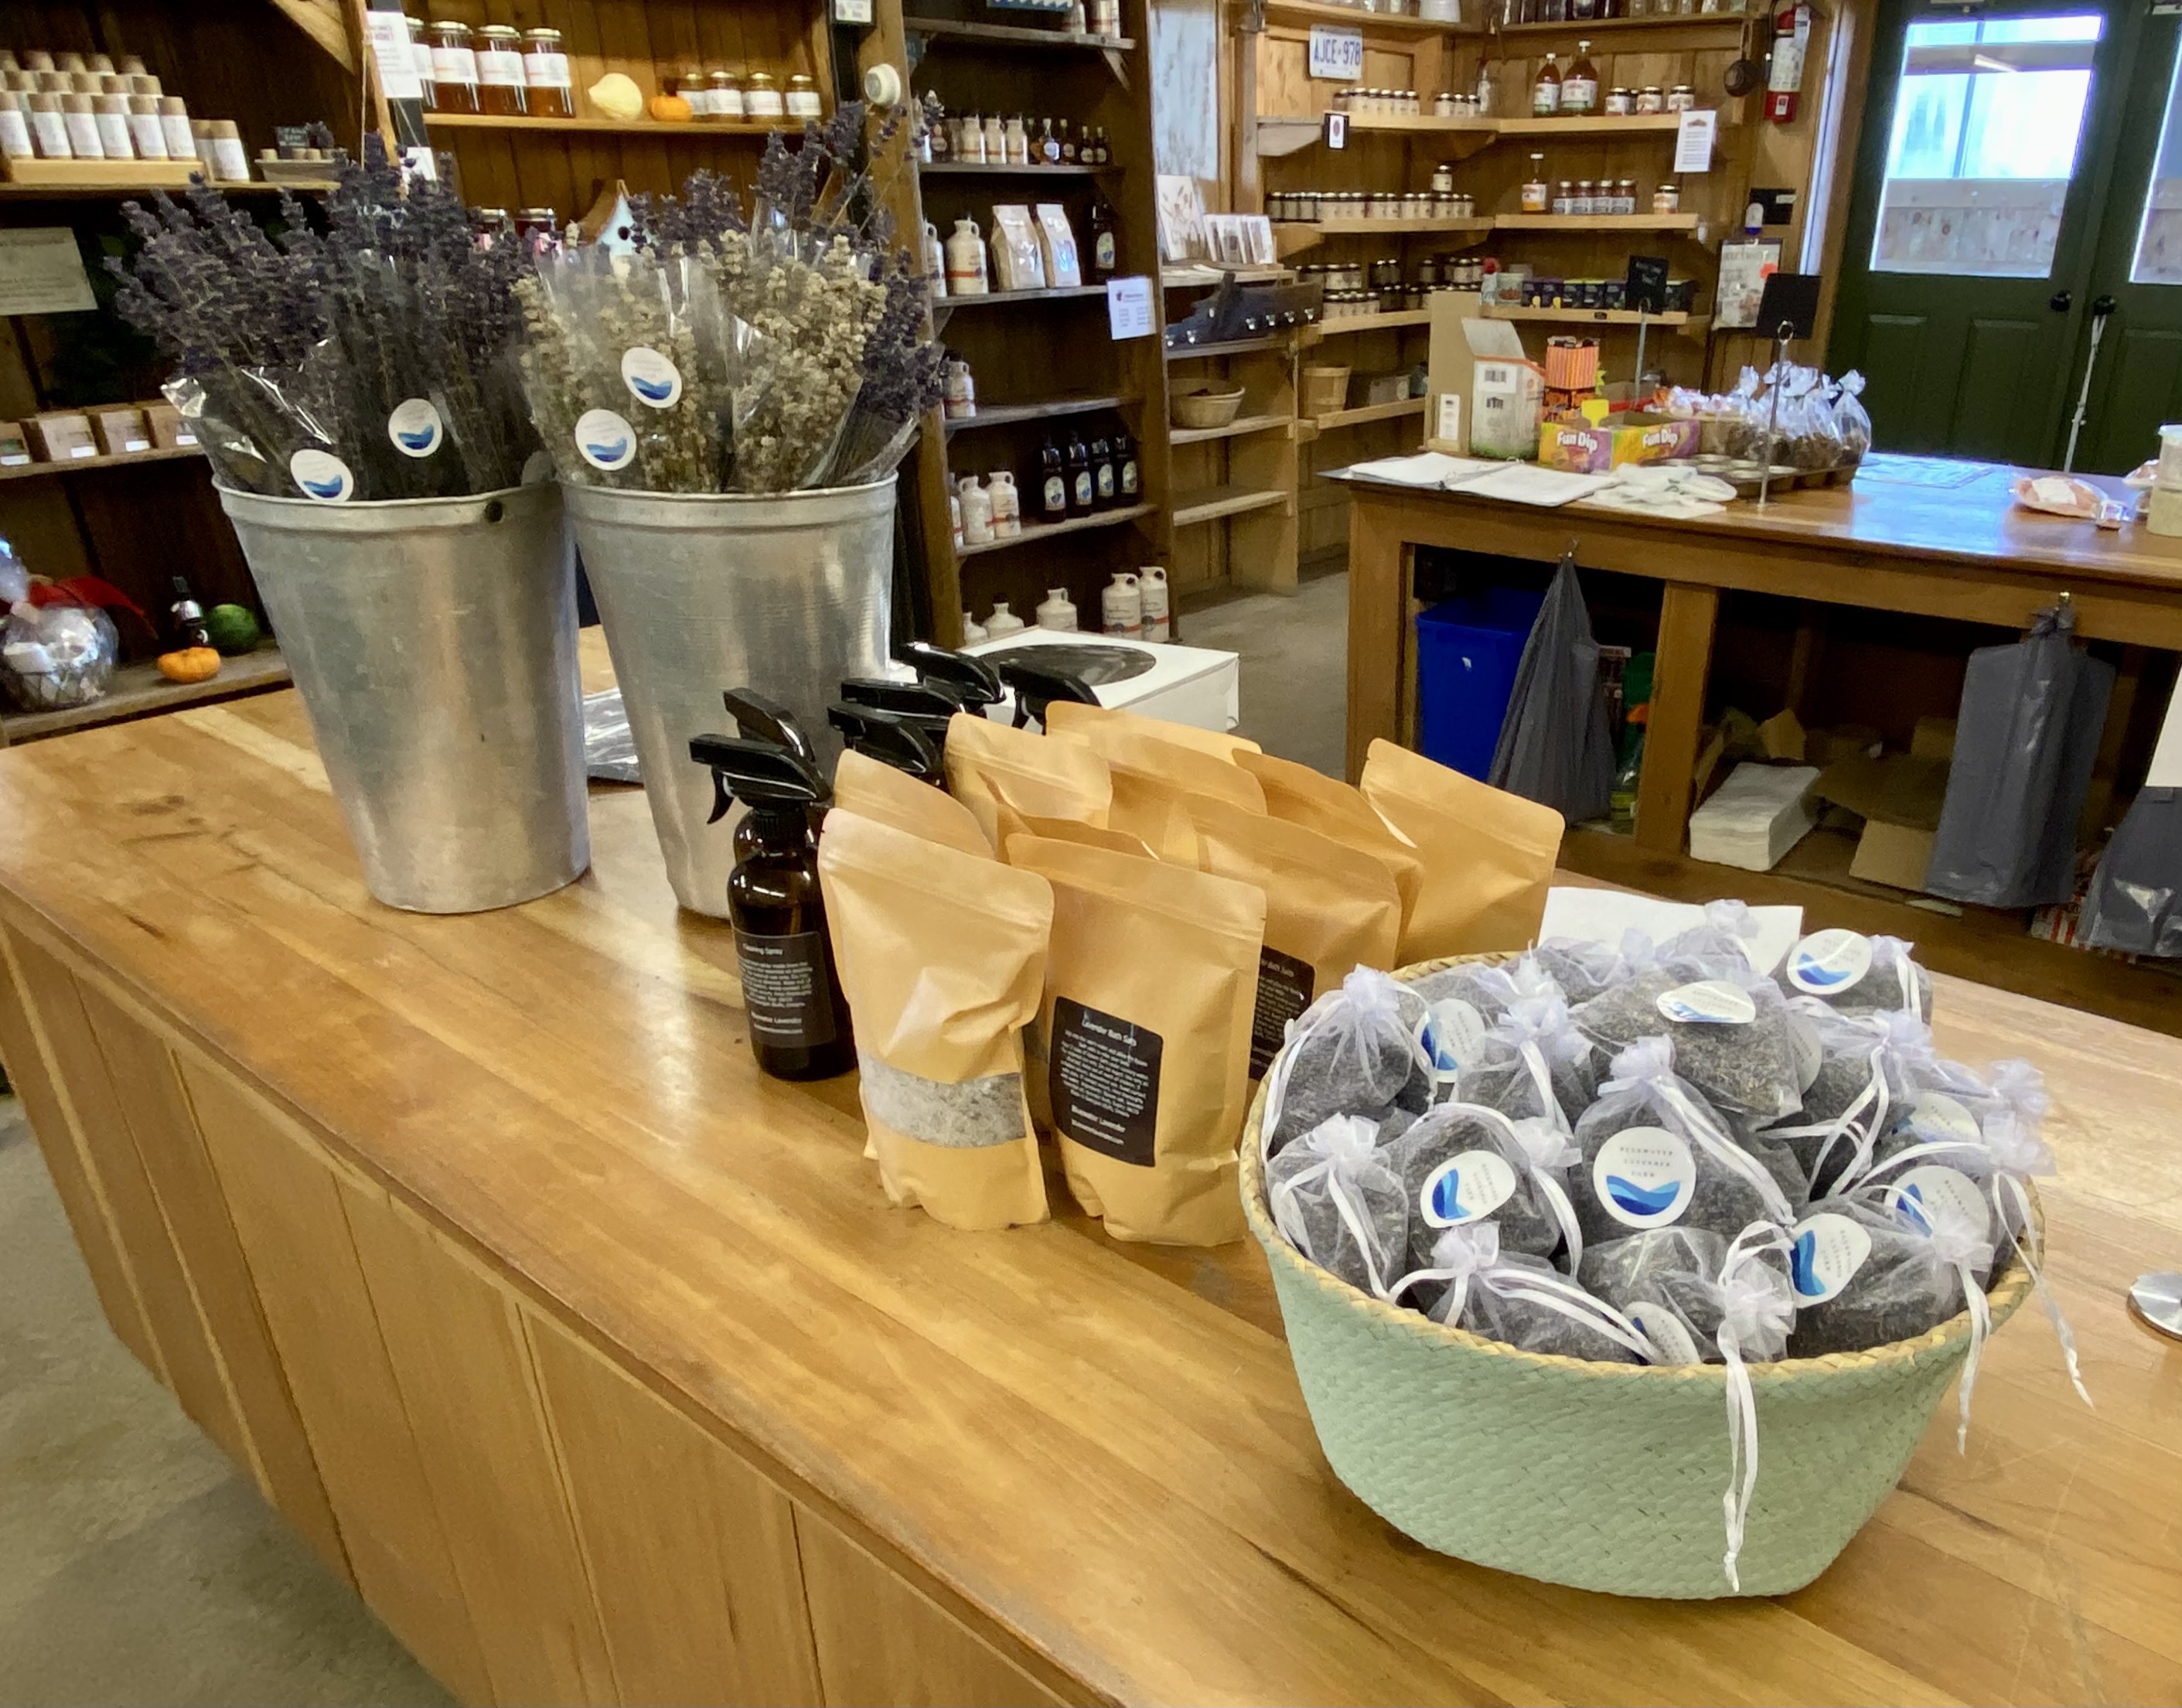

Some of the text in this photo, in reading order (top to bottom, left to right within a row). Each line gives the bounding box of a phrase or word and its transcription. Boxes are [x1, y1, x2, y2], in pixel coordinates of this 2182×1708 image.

[1556, 431, 1597, 455] Fun Dip
[1642, 428, 1679, 449] Fun Dip
